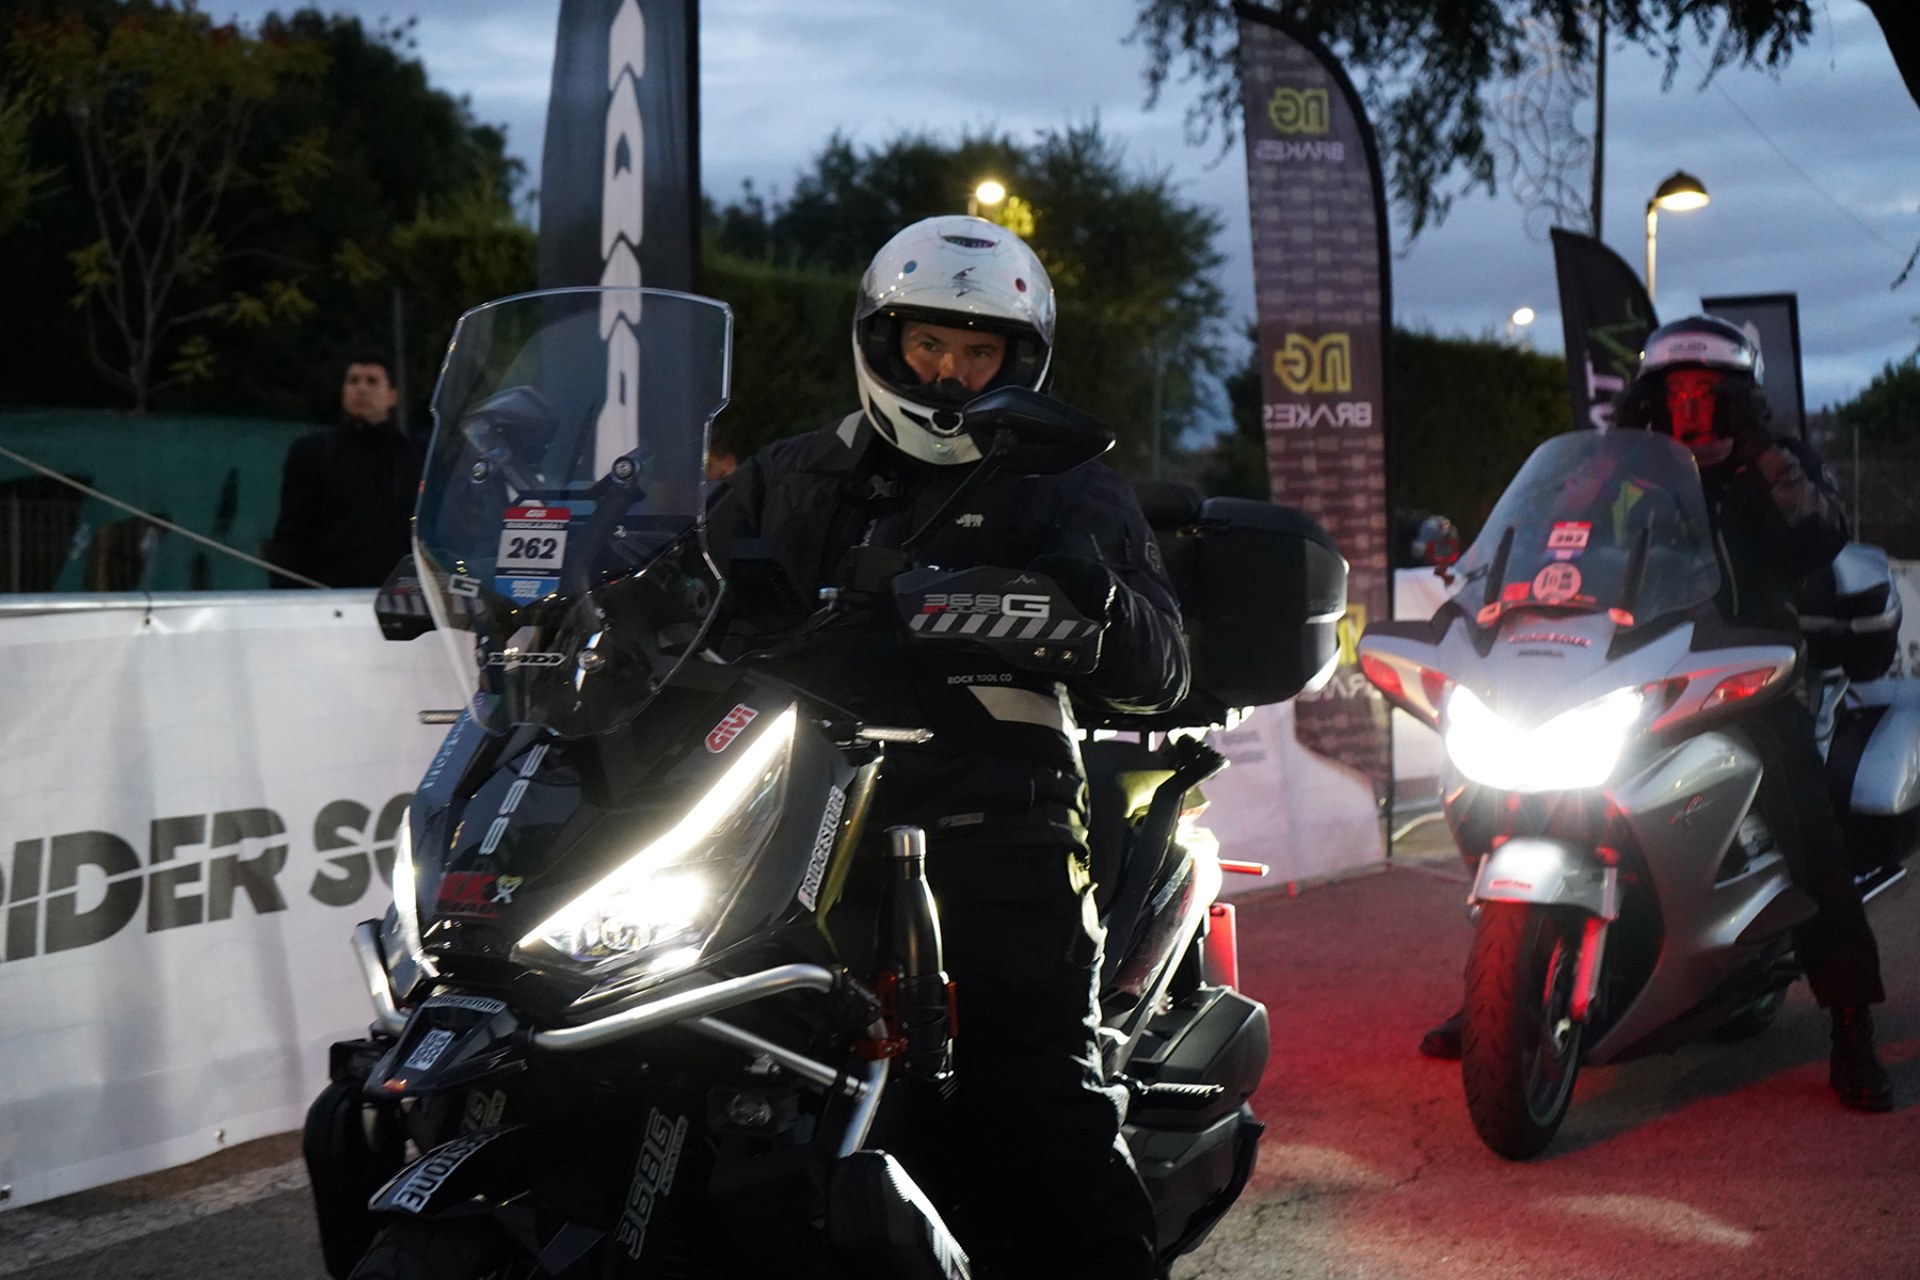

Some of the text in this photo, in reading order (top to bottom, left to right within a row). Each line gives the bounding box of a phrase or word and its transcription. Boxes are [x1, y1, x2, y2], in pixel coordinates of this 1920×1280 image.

[507, 537, 558, 559] 262
[705, 704, 758, 753] GIVI
[0, 807, 290, 962] IDER
[798, 785, 847, 911] BRIDGESTONE
